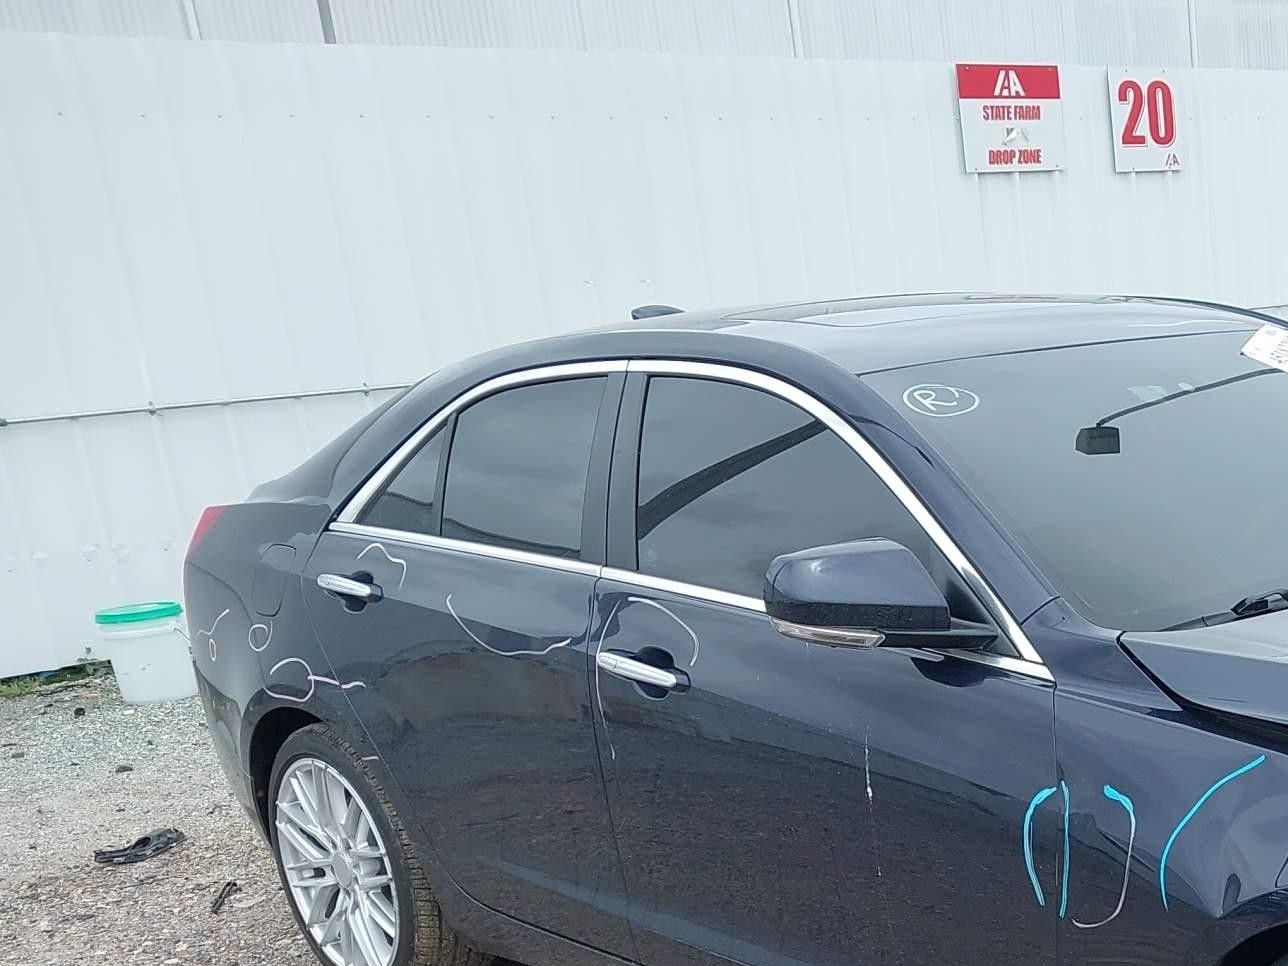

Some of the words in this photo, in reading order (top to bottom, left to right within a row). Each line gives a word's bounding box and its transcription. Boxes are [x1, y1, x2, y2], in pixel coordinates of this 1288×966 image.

[982, 104, 1012, 121] STATE
[1014, 104, 1041, 121] FARM
[1118, 80, 1176, 147] 20
[988, 149, 1016, 165] DROP
[1017, 148, 1042, 164] ZONE
